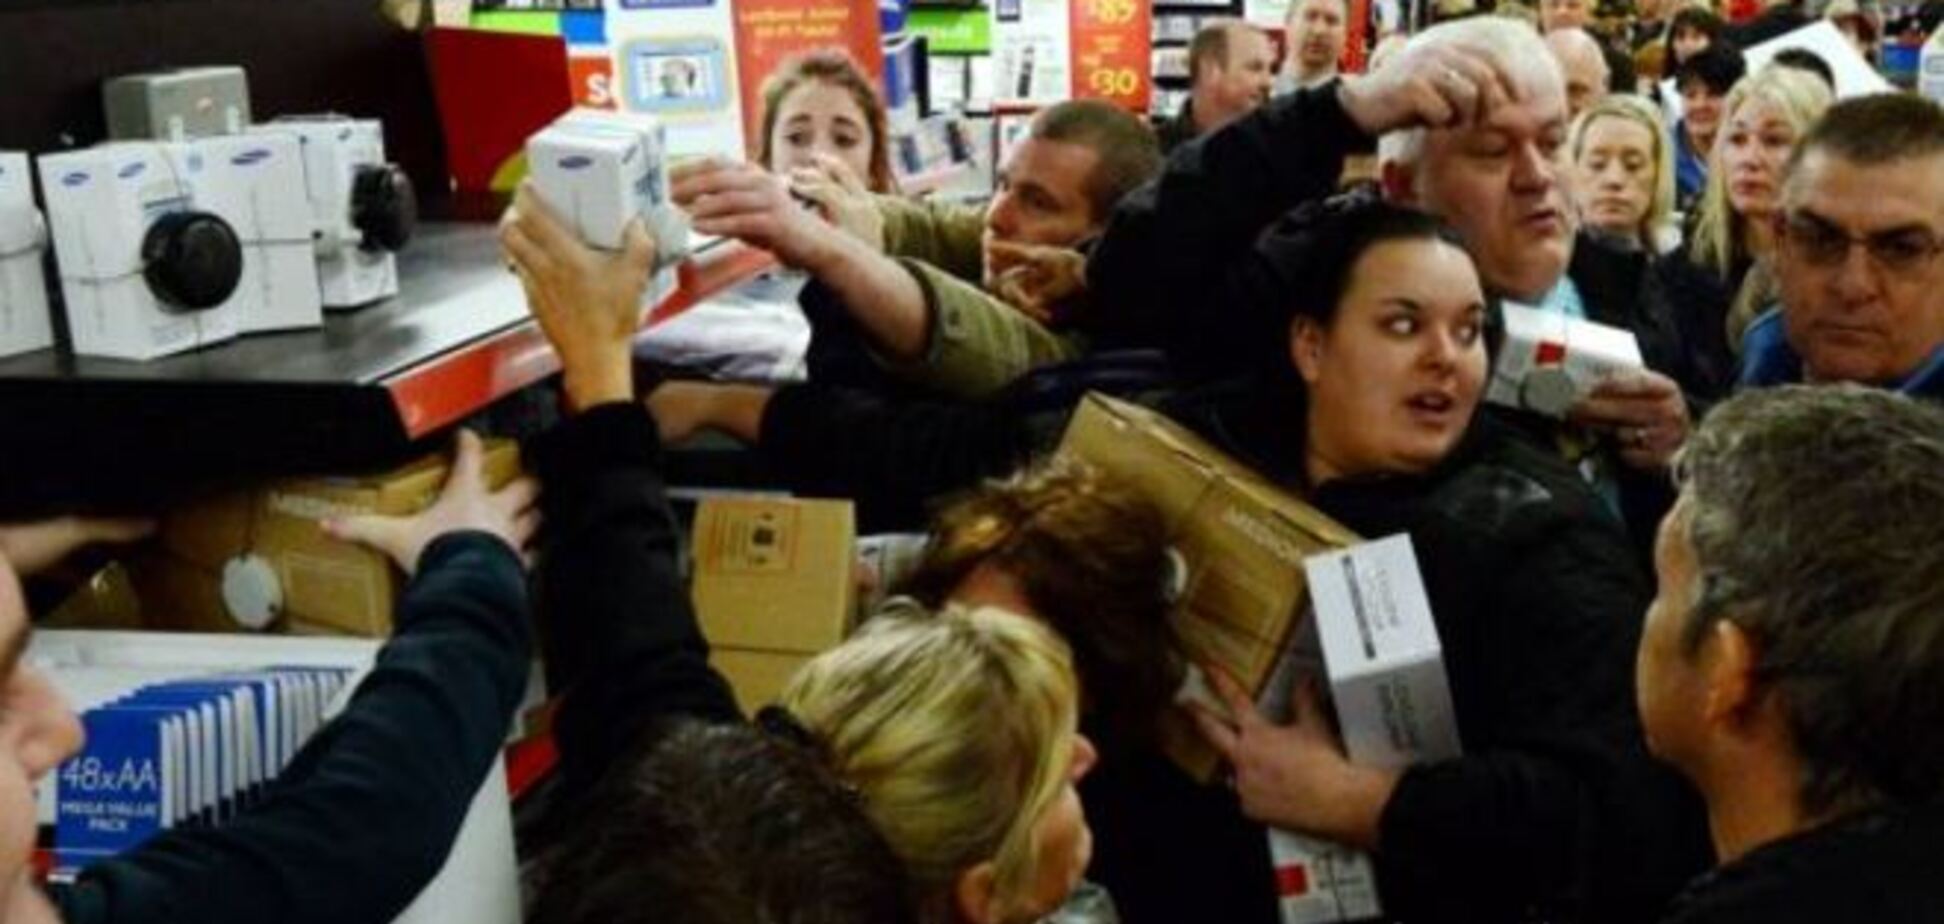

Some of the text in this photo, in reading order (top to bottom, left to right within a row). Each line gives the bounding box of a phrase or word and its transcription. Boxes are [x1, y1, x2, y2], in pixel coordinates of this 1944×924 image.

[1088, 68, 1139, 96] £30
[62, 756, 158, 792] 48xAA
[88, 818, 129, 832] PACK
